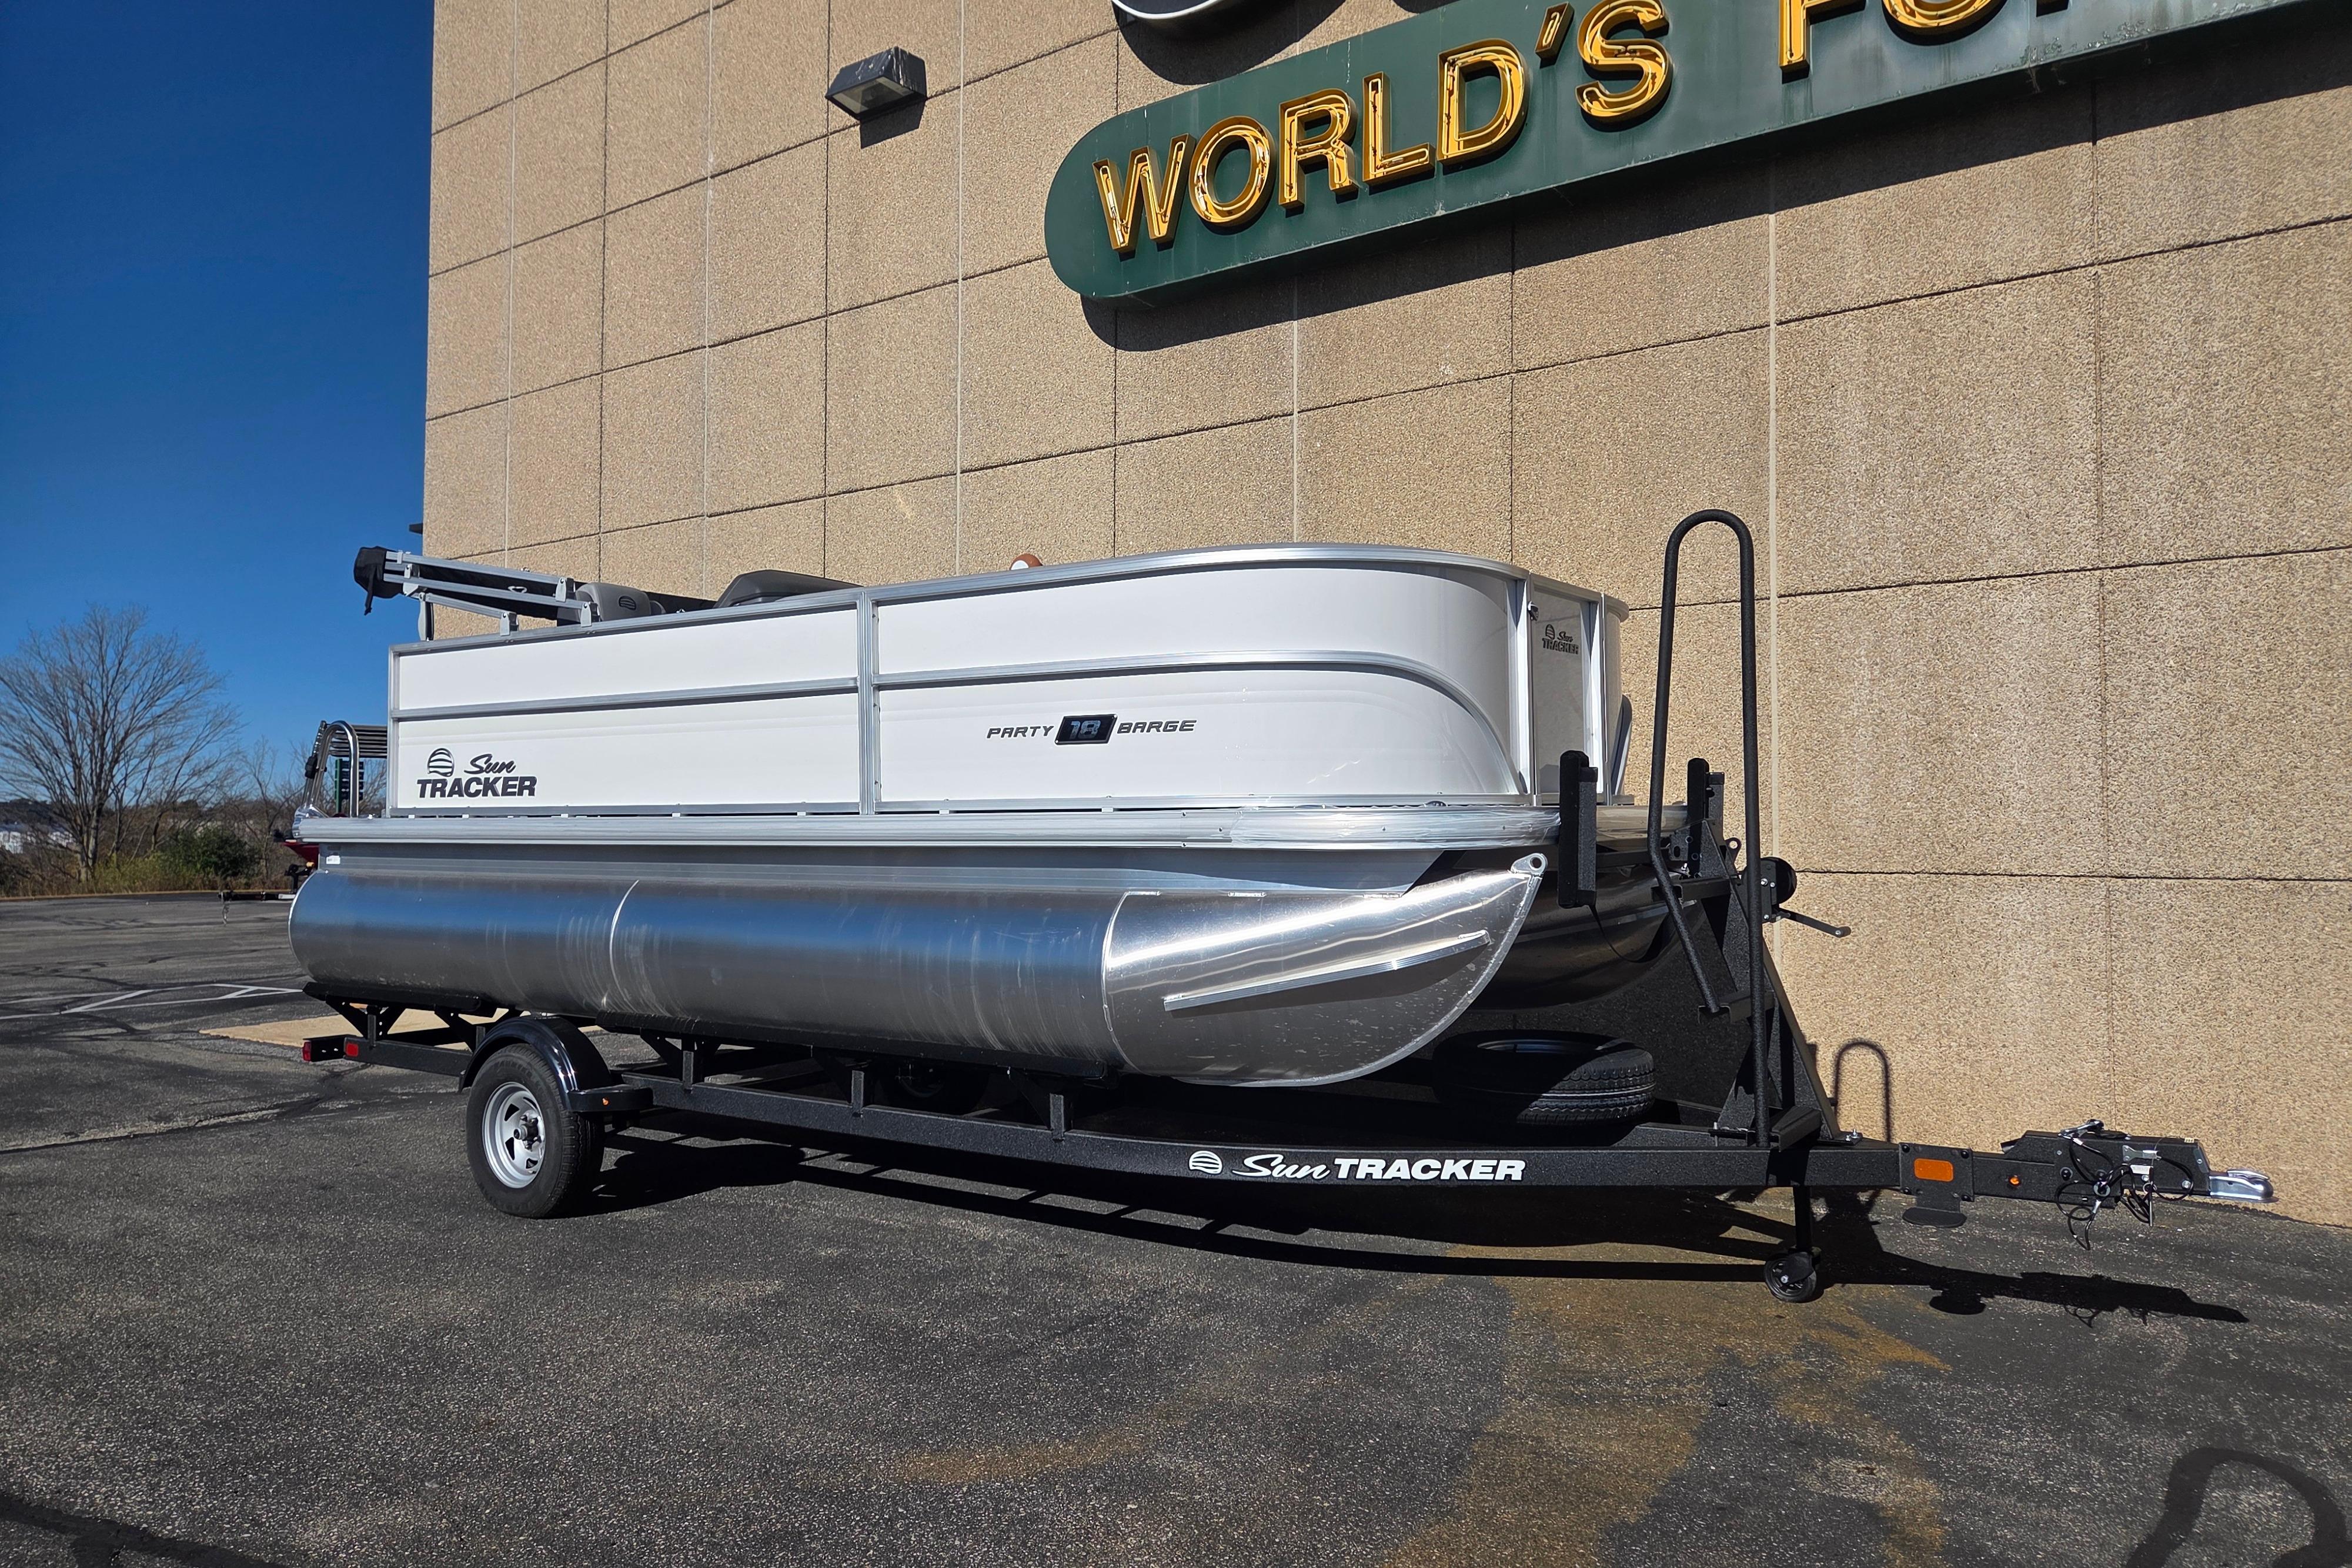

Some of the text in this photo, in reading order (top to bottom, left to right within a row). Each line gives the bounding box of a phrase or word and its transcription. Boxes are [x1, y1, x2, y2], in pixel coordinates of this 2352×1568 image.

[1093, 0, 1673, 253] WORLD'S
[1542, 638, 1579, 654] TRACKER
[1557, 631, 1573, 643] Sun
[987, 720, 1197, 739] PARTY 18 BARGE
[463, 753, 516, 774] Sun
[417, 776, 537, 798] TRACKER
[1232, 1154, 1526, 1180] Sun TRACKER
